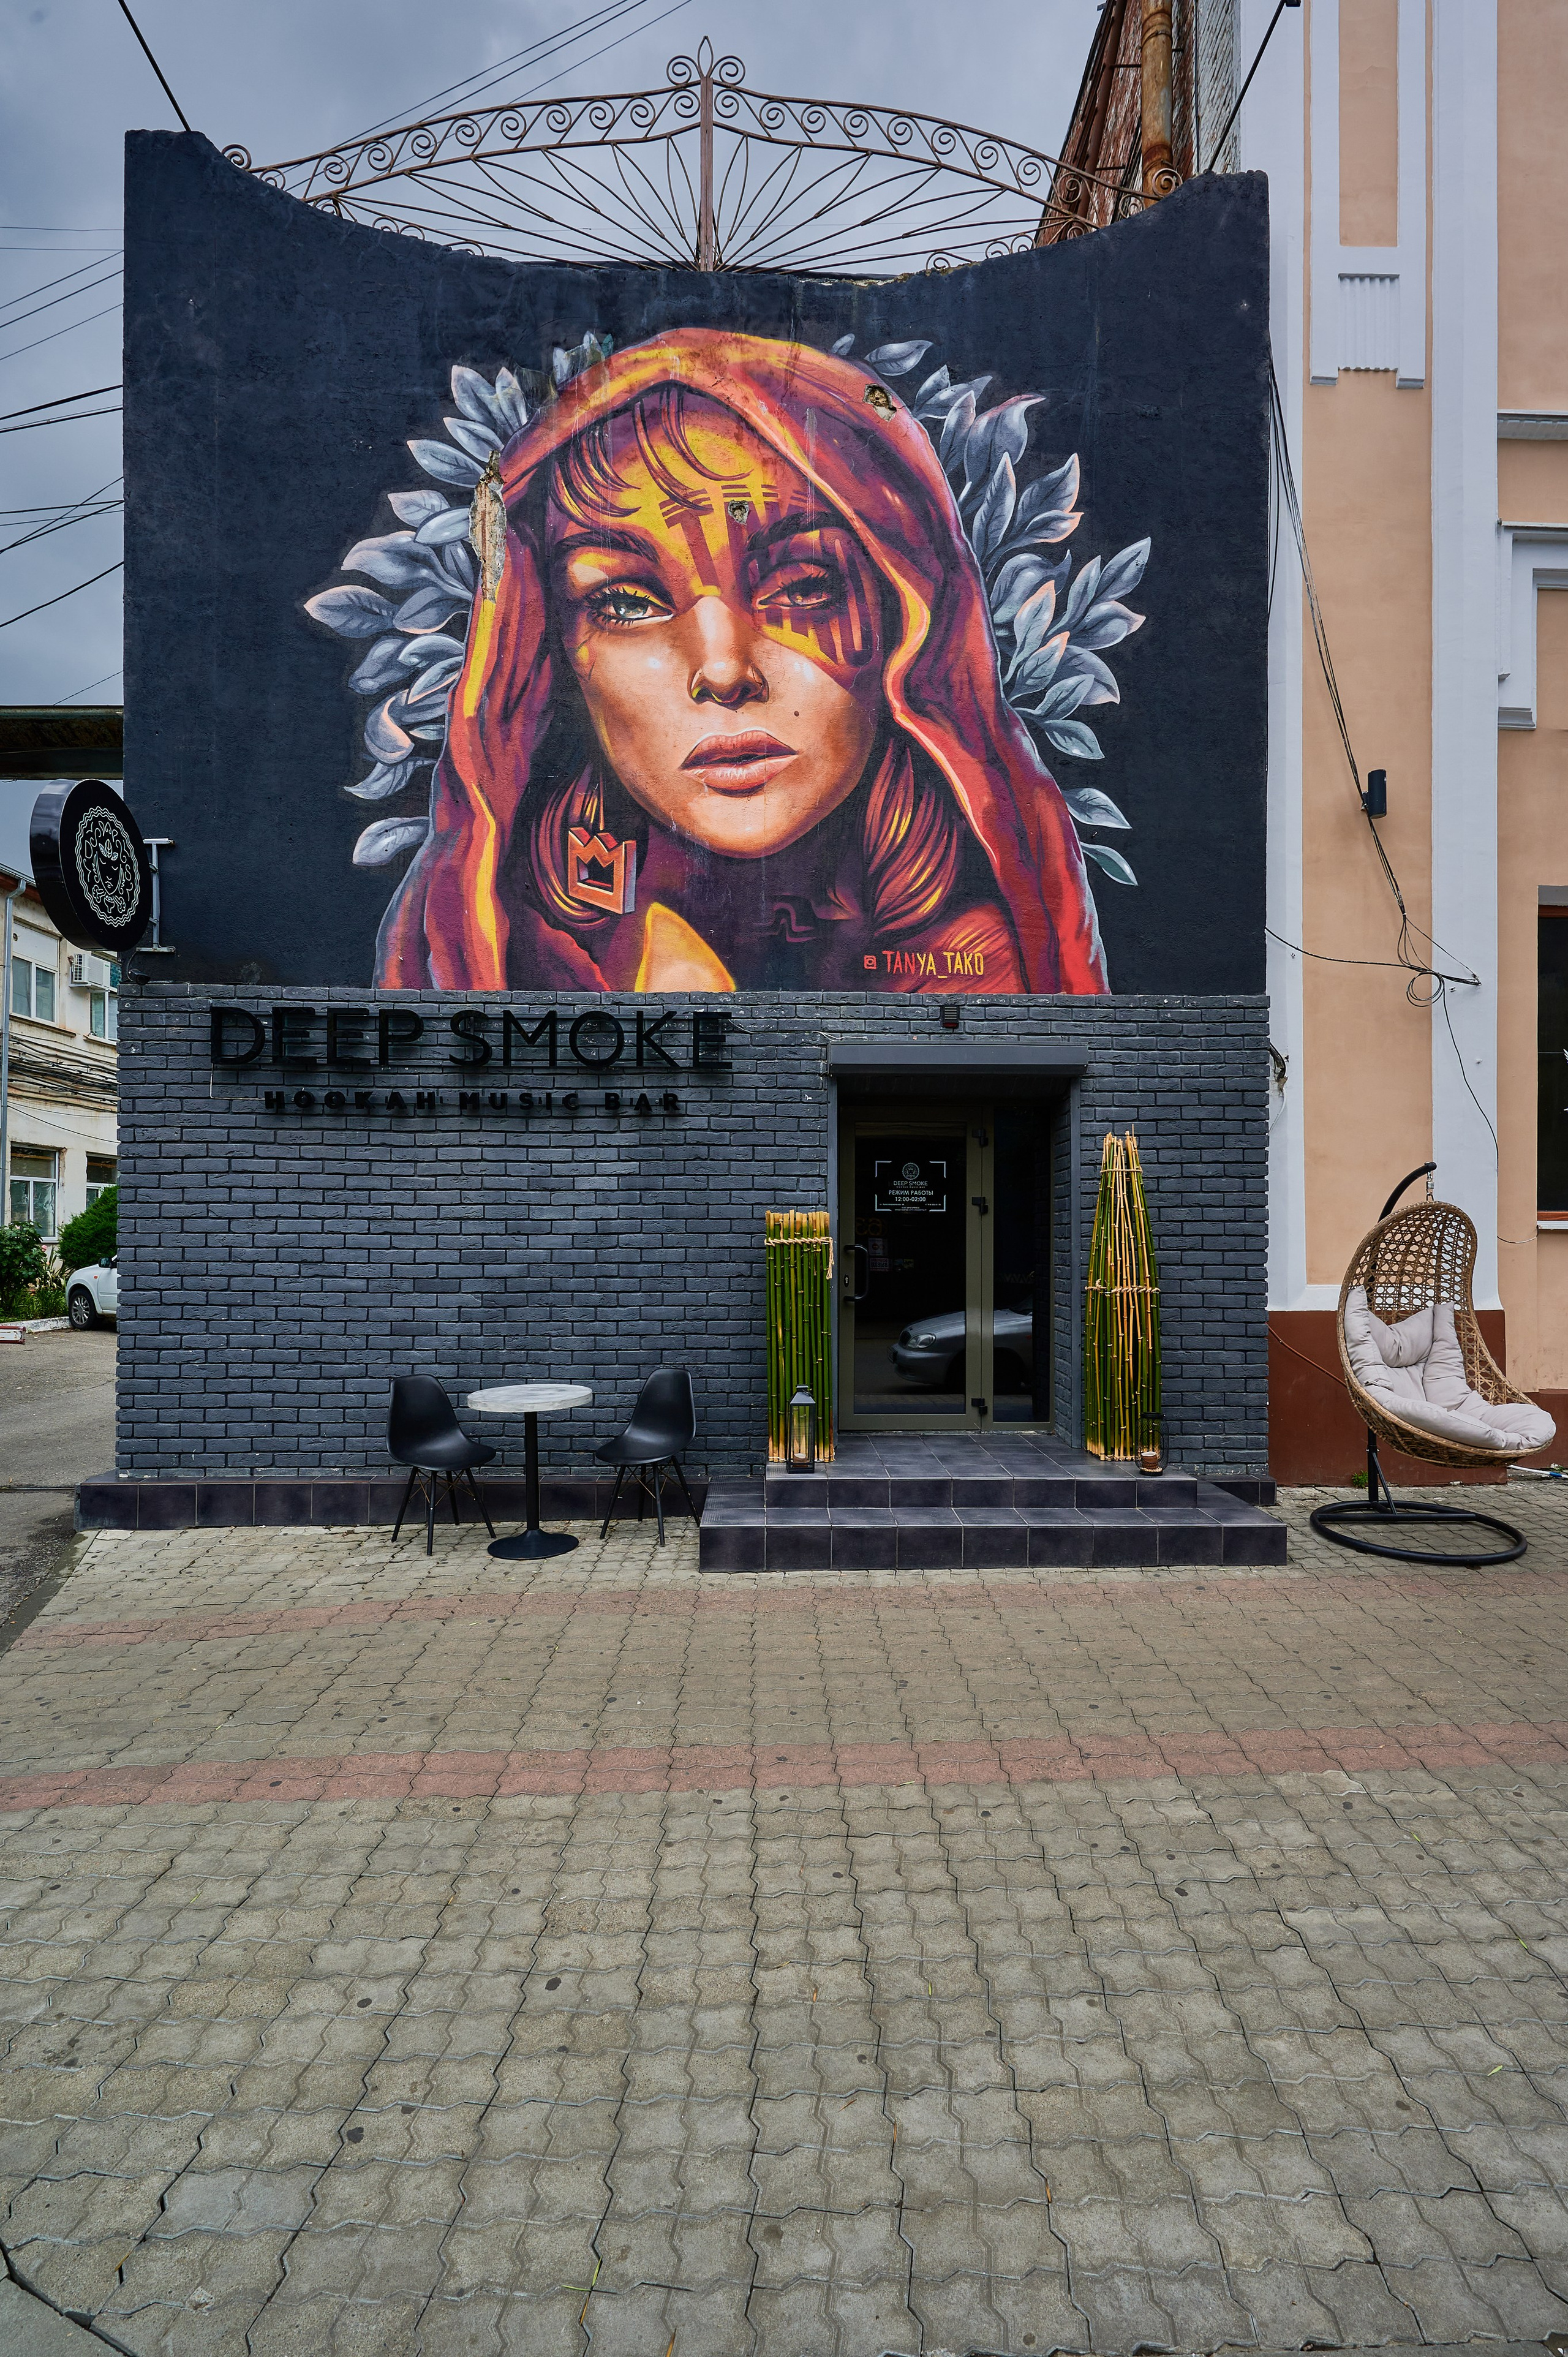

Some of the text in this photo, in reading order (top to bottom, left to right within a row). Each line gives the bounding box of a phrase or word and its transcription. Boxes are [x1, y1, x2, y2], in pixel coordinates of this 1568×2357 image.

[882, 950, 984, 979] TANYA_TAKO
[210, 1006, 733, 1069] DEEP SMOKE
[264, 1090, 680, 1112] HOOKAH MUSIC BAR
